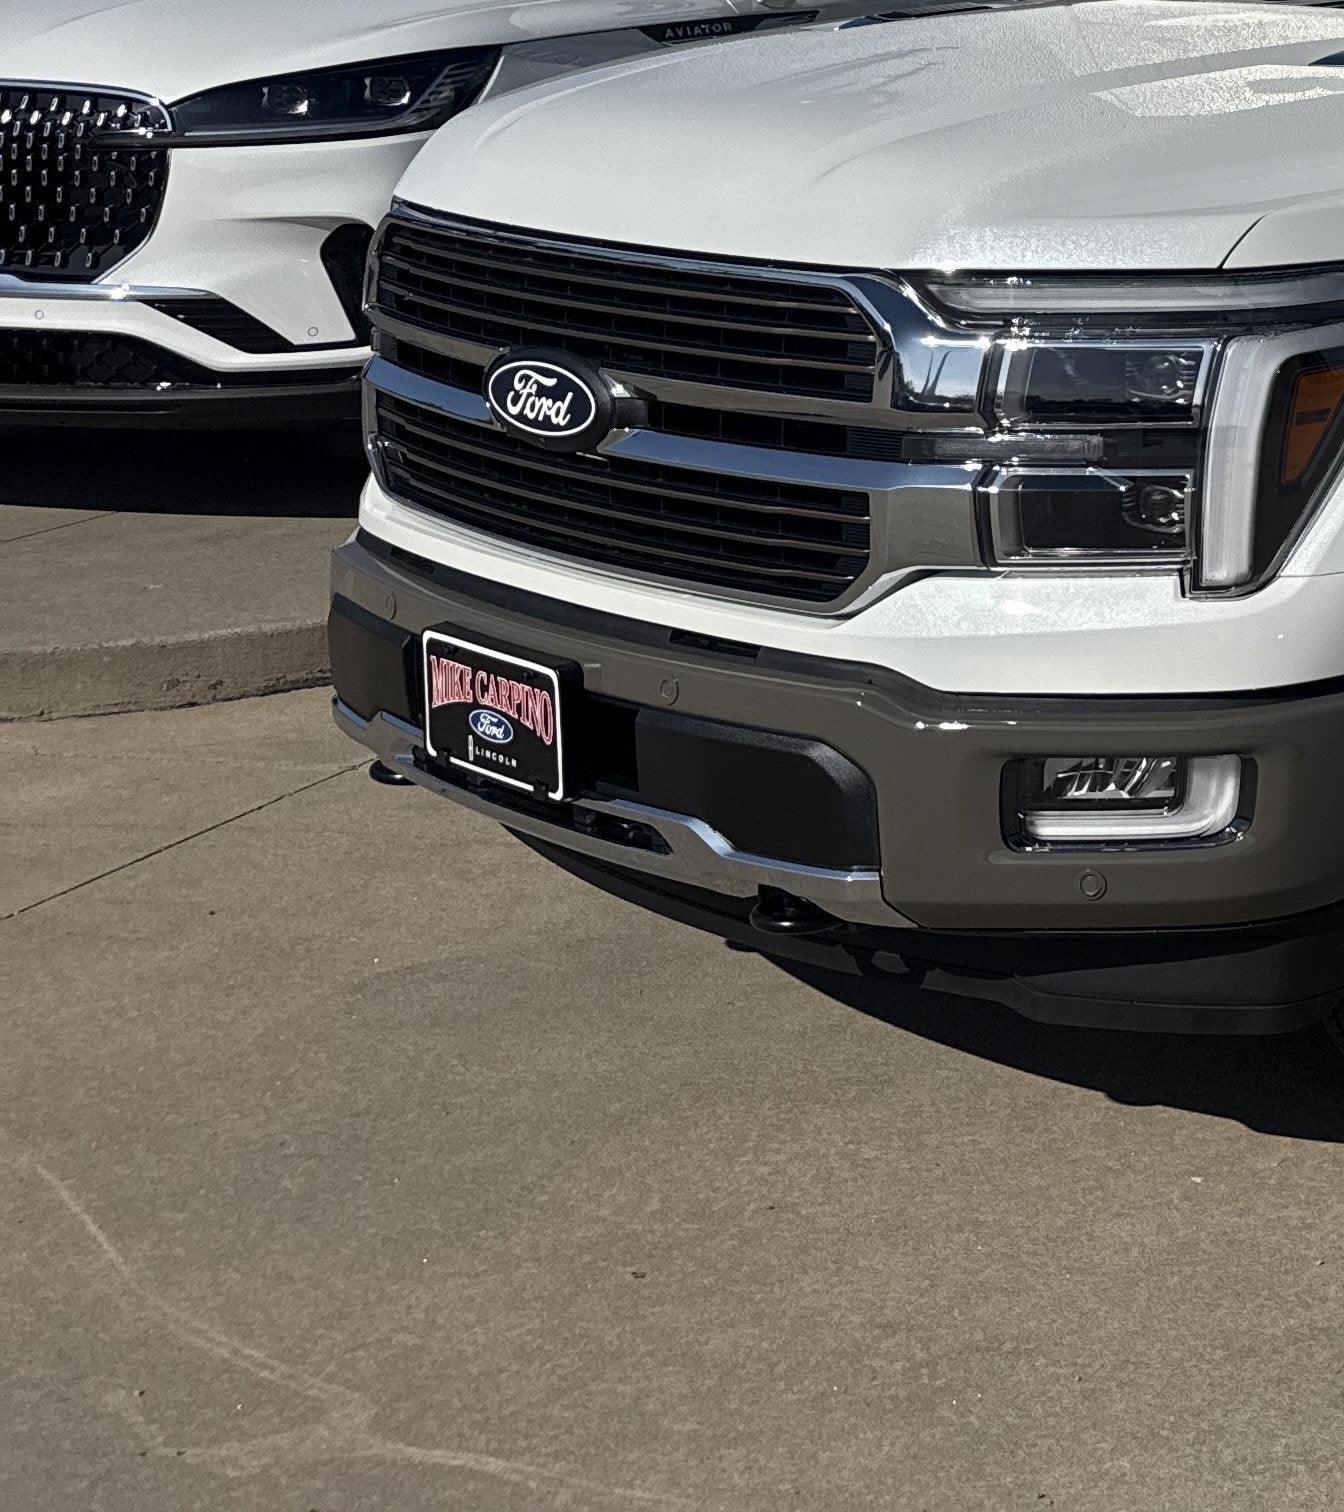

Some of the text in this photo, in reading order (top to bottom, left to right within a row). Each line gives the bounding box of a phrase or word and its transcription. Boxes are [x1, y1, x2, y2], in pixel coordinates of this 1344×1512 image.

[664, 21, 734, 39] AVIATOR
[507, 369, 574, 426] Ford
[430, 655, 554, 746] MIKE CARPINO
[477, 712, 505, 740] Ford
[475, 745, 518, 768] LINCOLN
